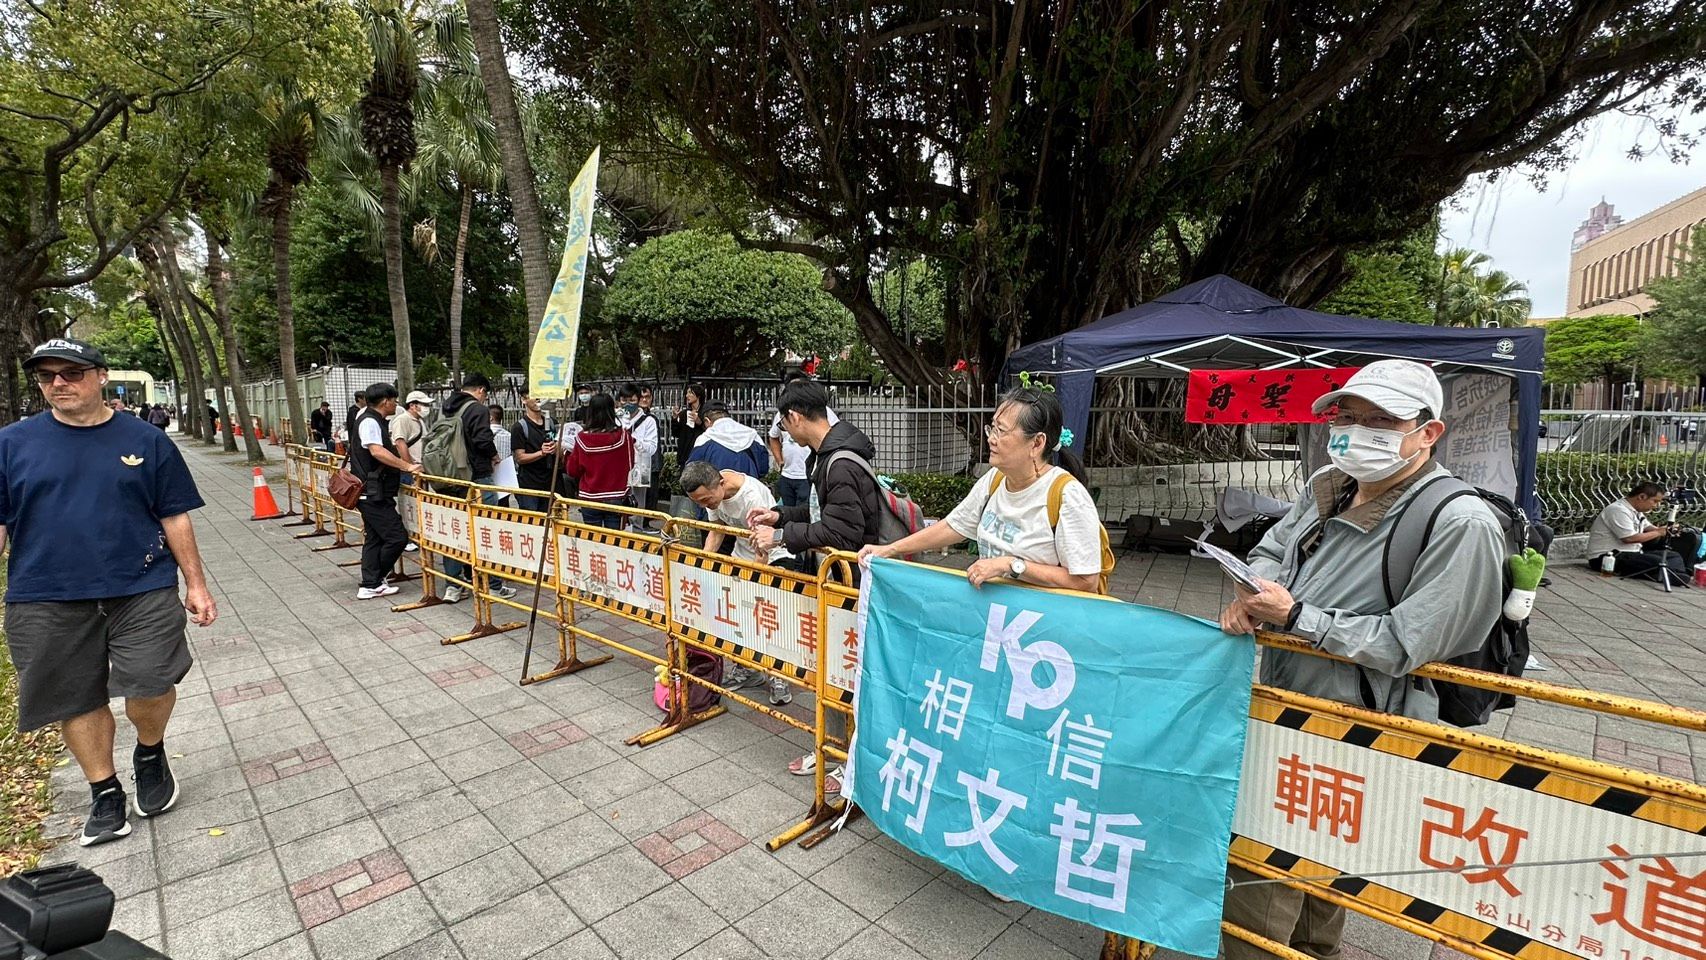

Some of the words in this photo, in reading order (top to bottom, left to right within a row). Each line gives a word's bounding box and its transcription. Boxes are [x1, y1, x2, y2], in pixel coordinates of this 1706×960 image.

[424, 510, 471, 541] 禁止停
[679, 576, 817, 655] 禁止停車
[979, 603, 1076, 720] KP
[878, 728, 1146, 915] 柯文哲
[1474, 899, 1604, 957] 松山分局
